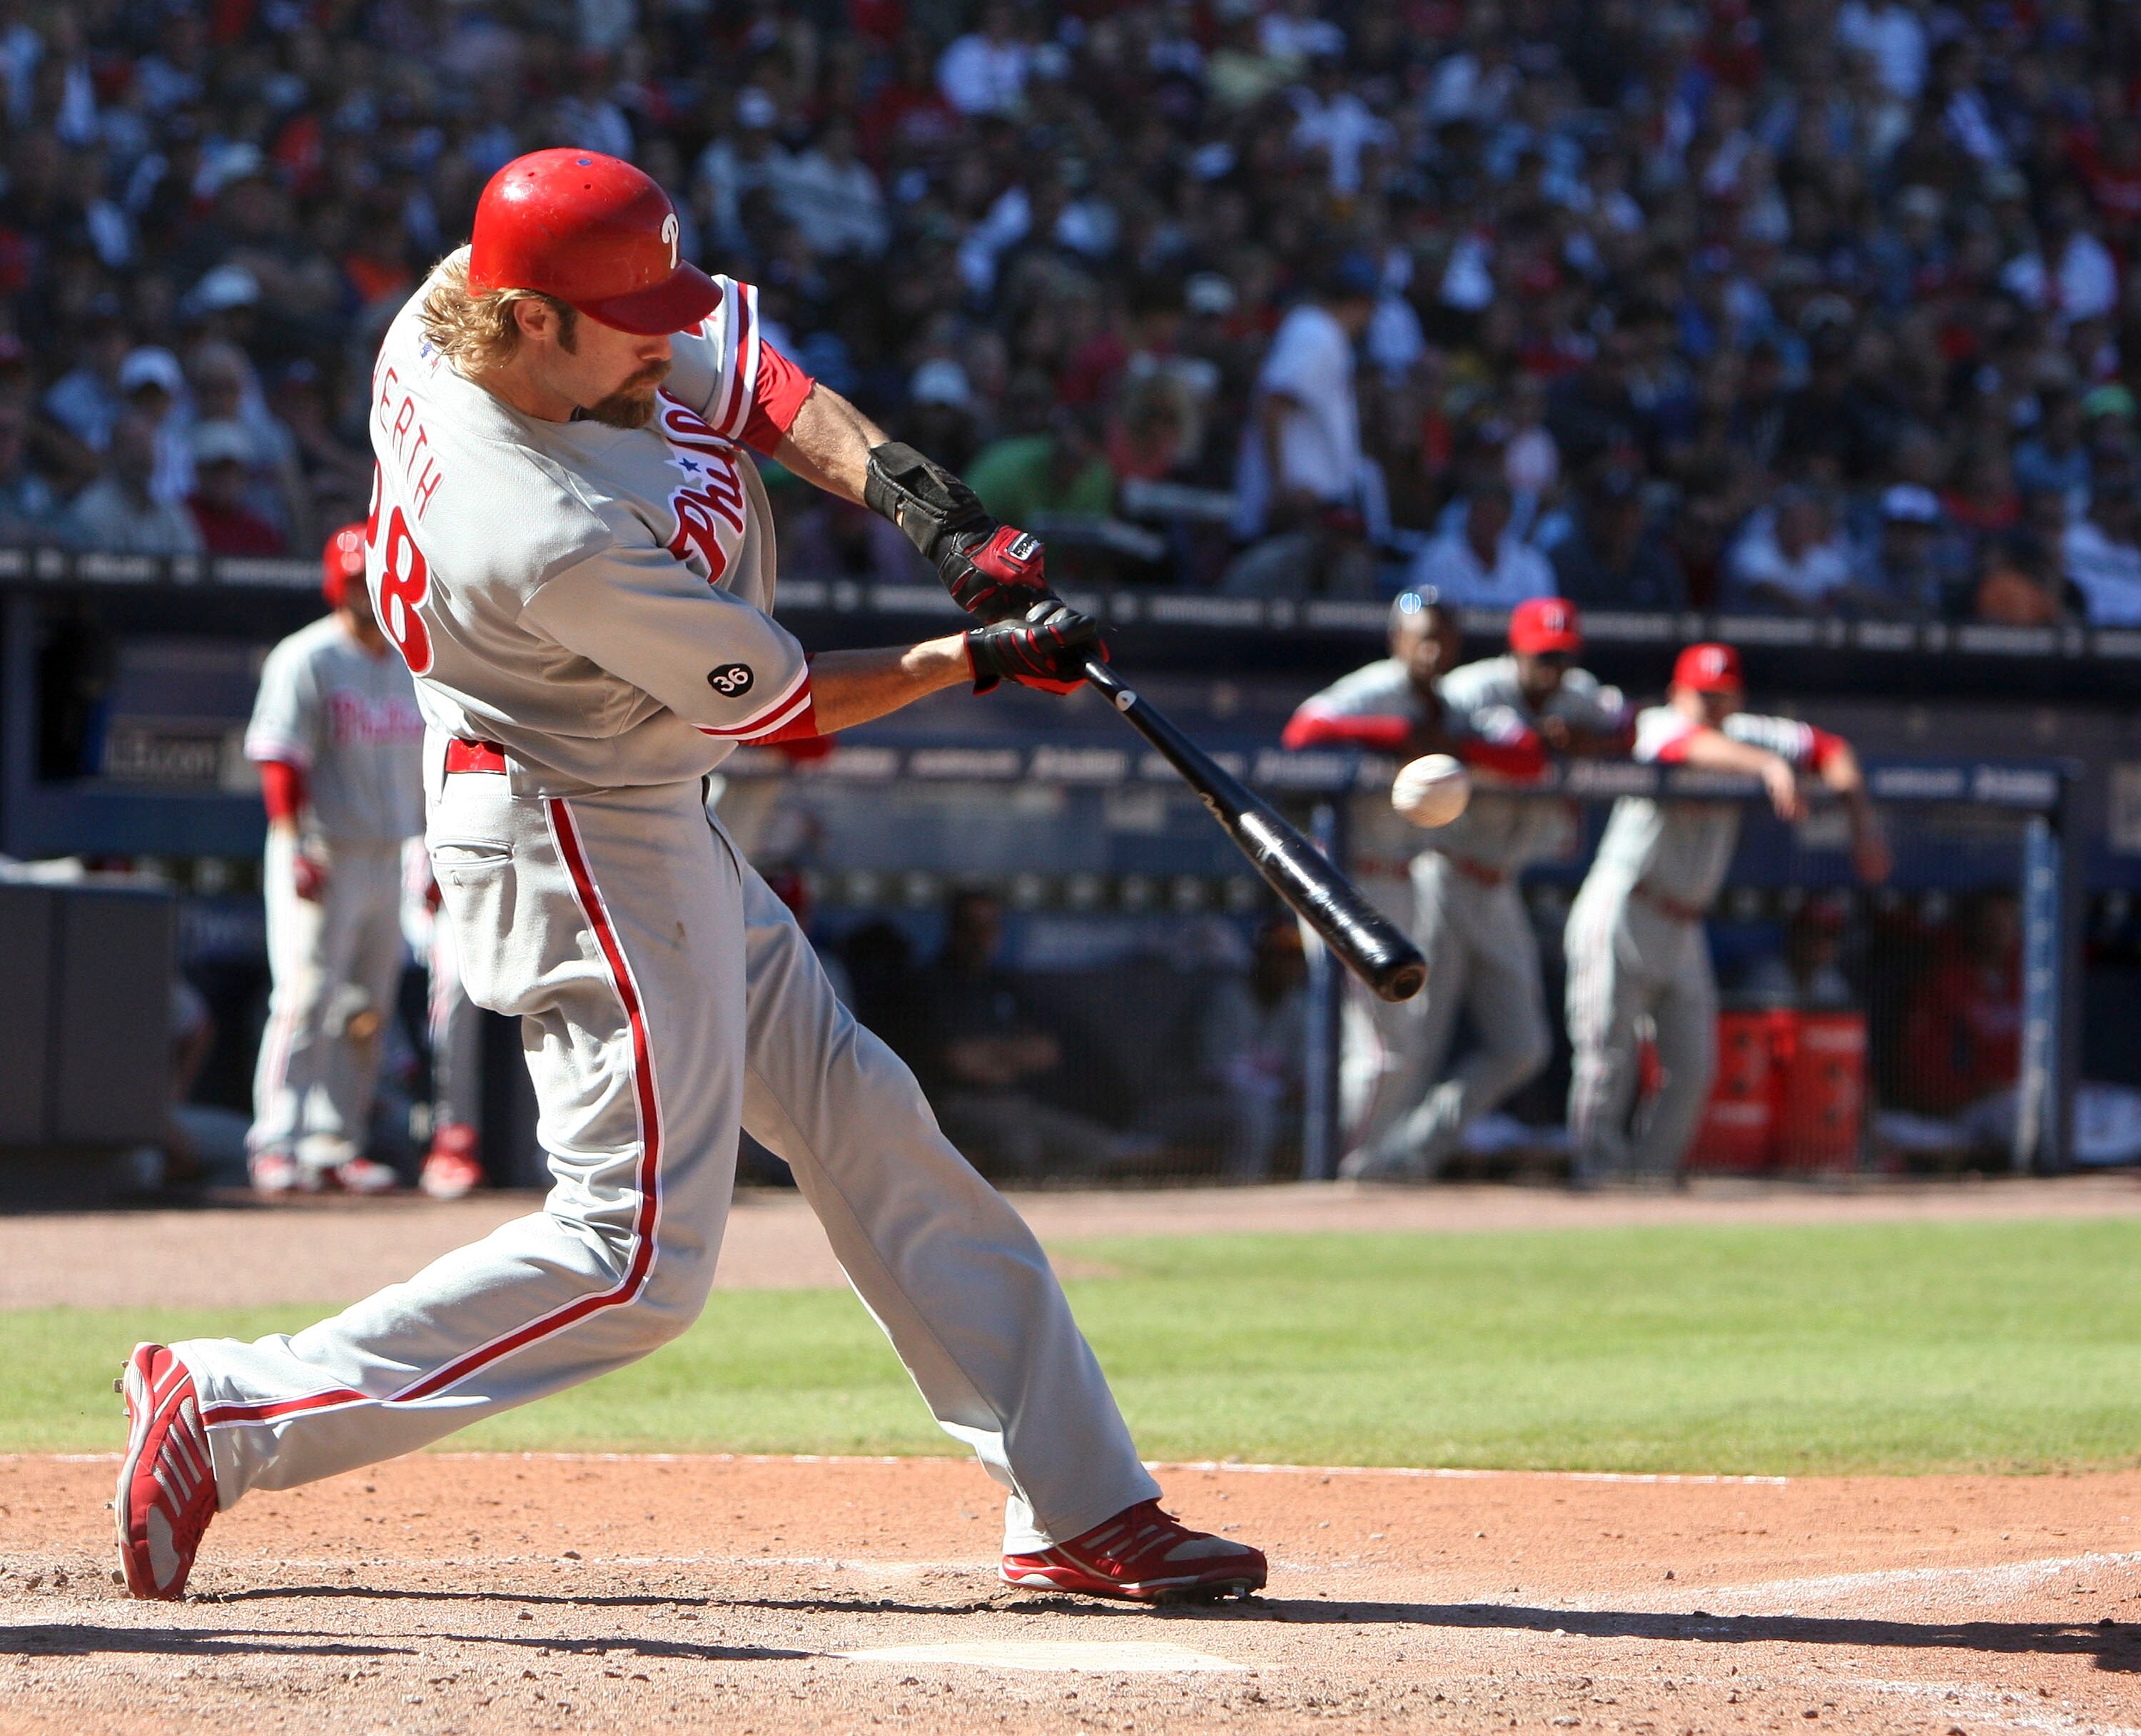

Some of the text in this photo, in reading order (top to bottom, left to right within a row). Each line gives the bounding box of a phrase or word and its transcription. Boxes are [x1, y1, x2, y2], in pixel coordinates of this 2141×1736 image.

[661, 213, 679, 270] P
[371, 351, 442, 522] ERTH
[712, 667, 749, 692] 36
